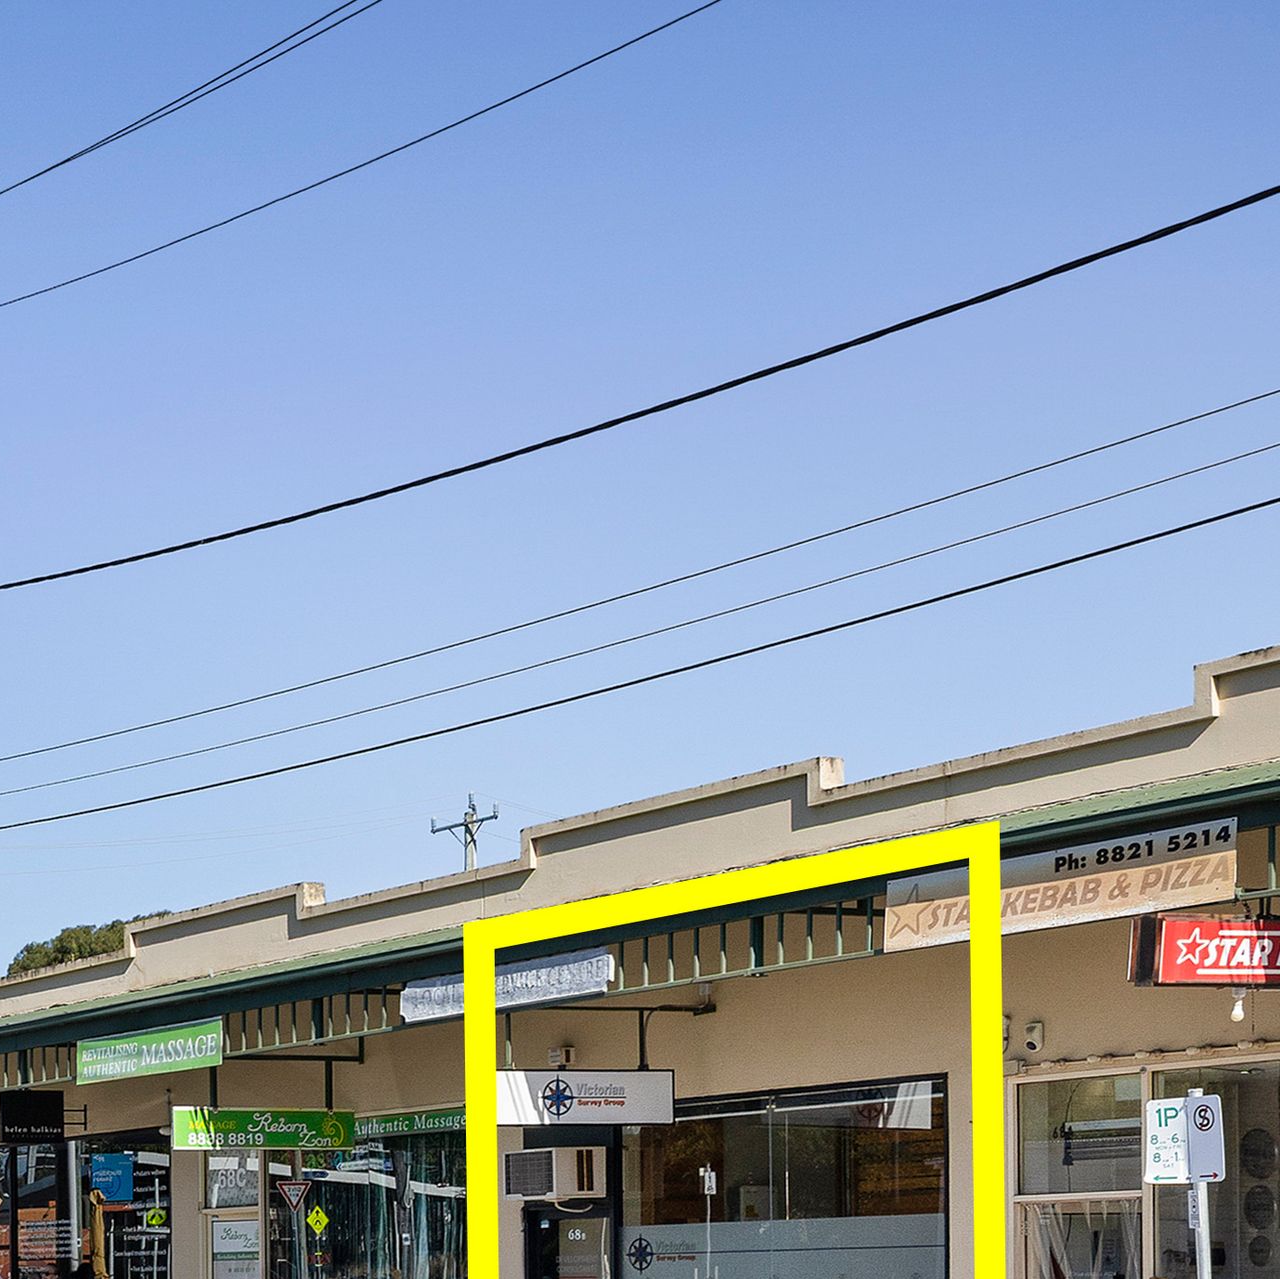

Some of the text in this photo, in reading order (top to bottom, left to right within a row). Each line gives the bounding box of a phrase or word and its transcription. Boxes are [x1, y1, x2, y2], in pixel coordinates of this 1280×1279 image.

[1054, 825, 1231, 873] Ph: 8821 5214
[927, 856, 1231, 931] STA KEBAB & PIZZA
[1205, 937, 1273, 967] STAR
[82, 1042, 138, 1062] REVITALISING
[140, 1033, 217, 1066] MASSAGE
[82, 1059, 138, 1078] AUTHENTIC
[577, 1083, 625, 1096] Victorian
[577, 1099, 625, 1107] Survey Group
[248, 1113, 307, 1132] Reborn
[414, 1113, 466, 1130] Massage
[1156, 1107, 1179, 1127] 1P
[228, 1132, 264, 1145] 8819
[218, 1168, 247, 1188] 68C
